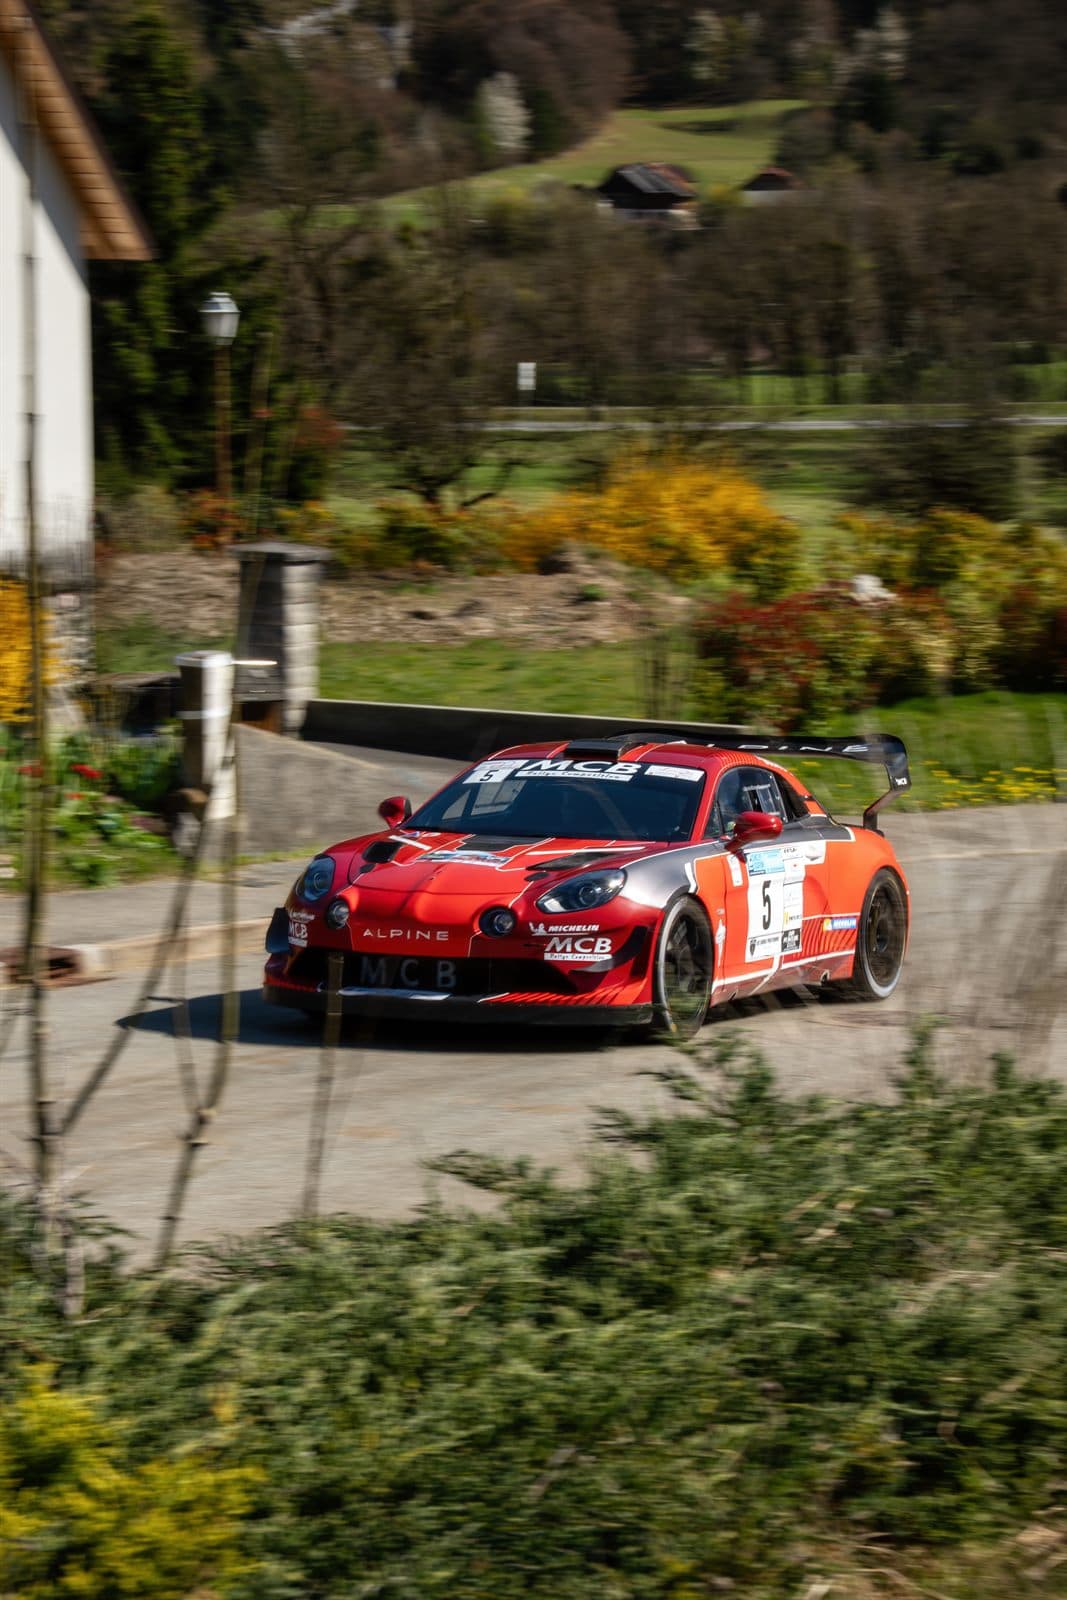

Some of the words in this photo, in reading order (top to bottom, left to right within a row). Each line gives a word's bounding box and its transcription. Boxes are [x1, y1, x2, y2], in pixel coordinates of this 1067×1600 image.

[520, 759, 642, 775] MCB
[480, 769, 500, 782] 5
[762, 880, 771, 930] 5
[363, 928, 449, 941] ALPINE
[548, 924, 600, 932] MICHELIN
[544, 937, 612, 953] MCB
[361, 956, 457, 988] MCB
